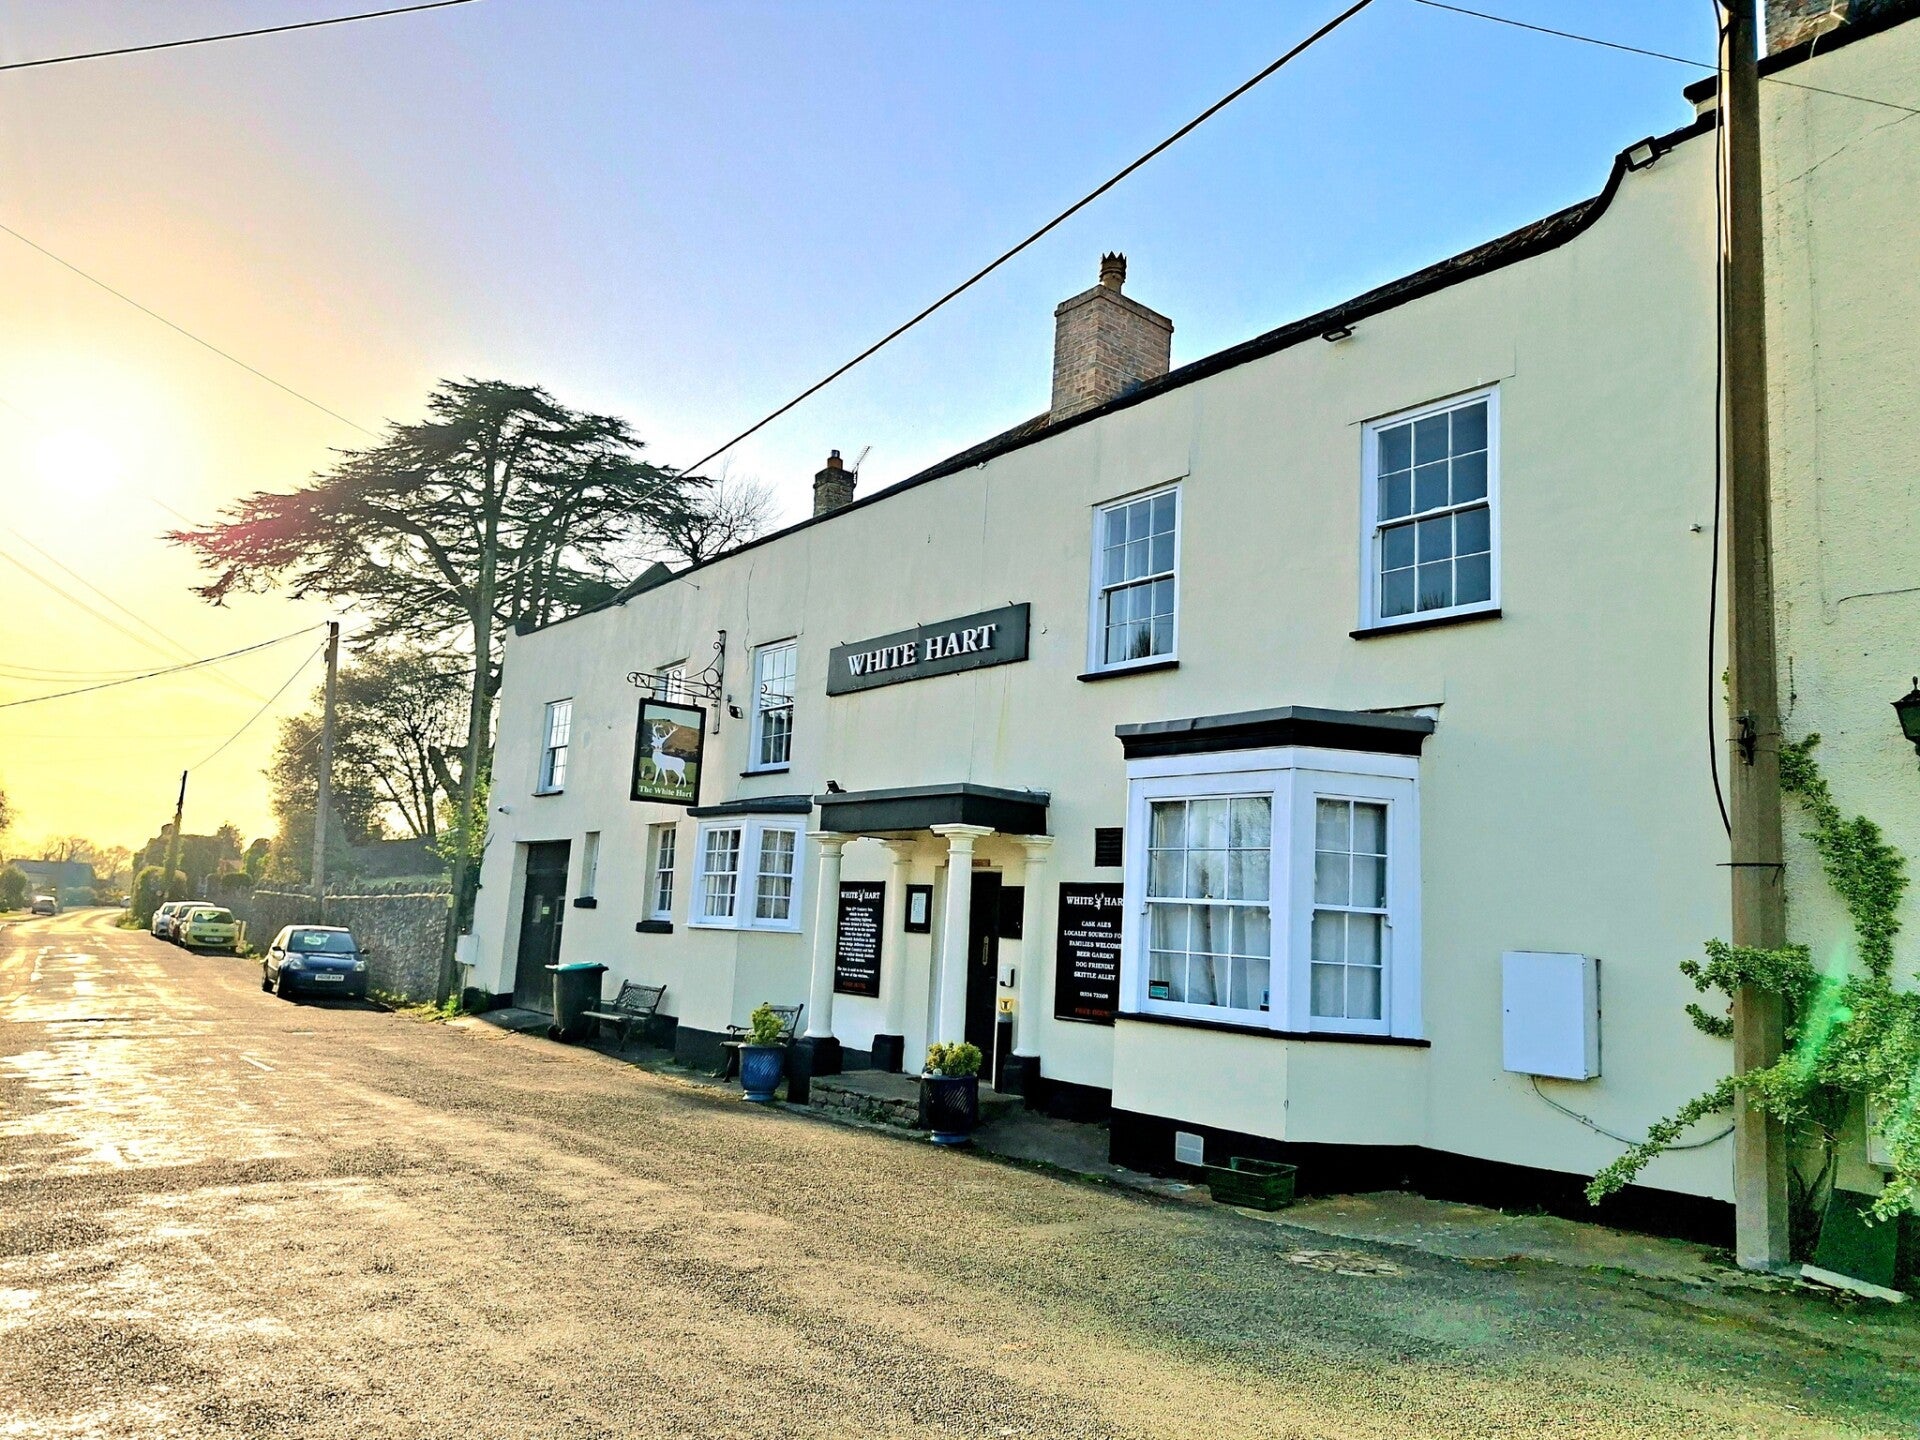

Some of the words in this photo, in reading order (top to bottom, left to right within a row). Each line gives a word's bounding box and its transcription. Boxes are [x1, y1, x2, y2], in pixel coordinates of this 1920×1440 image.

[848, 641, 916, 676] WHITE
[924, 623, 996, 661] HART
[639, 785, 653, 793] The
[654, 787, 675, 796] White
[676, 789, 692, 798] Hart
[841, 891, 859, 899] WHITE
[864, 891, 880, 899] HART
[1066, 896, 1094, 905] WHITE
[1104, 897, 1124, 906] HAR
[1088, 931, 1113, 939] SOURCED
[1088, 962, 1114, 970] FRIENDLY
